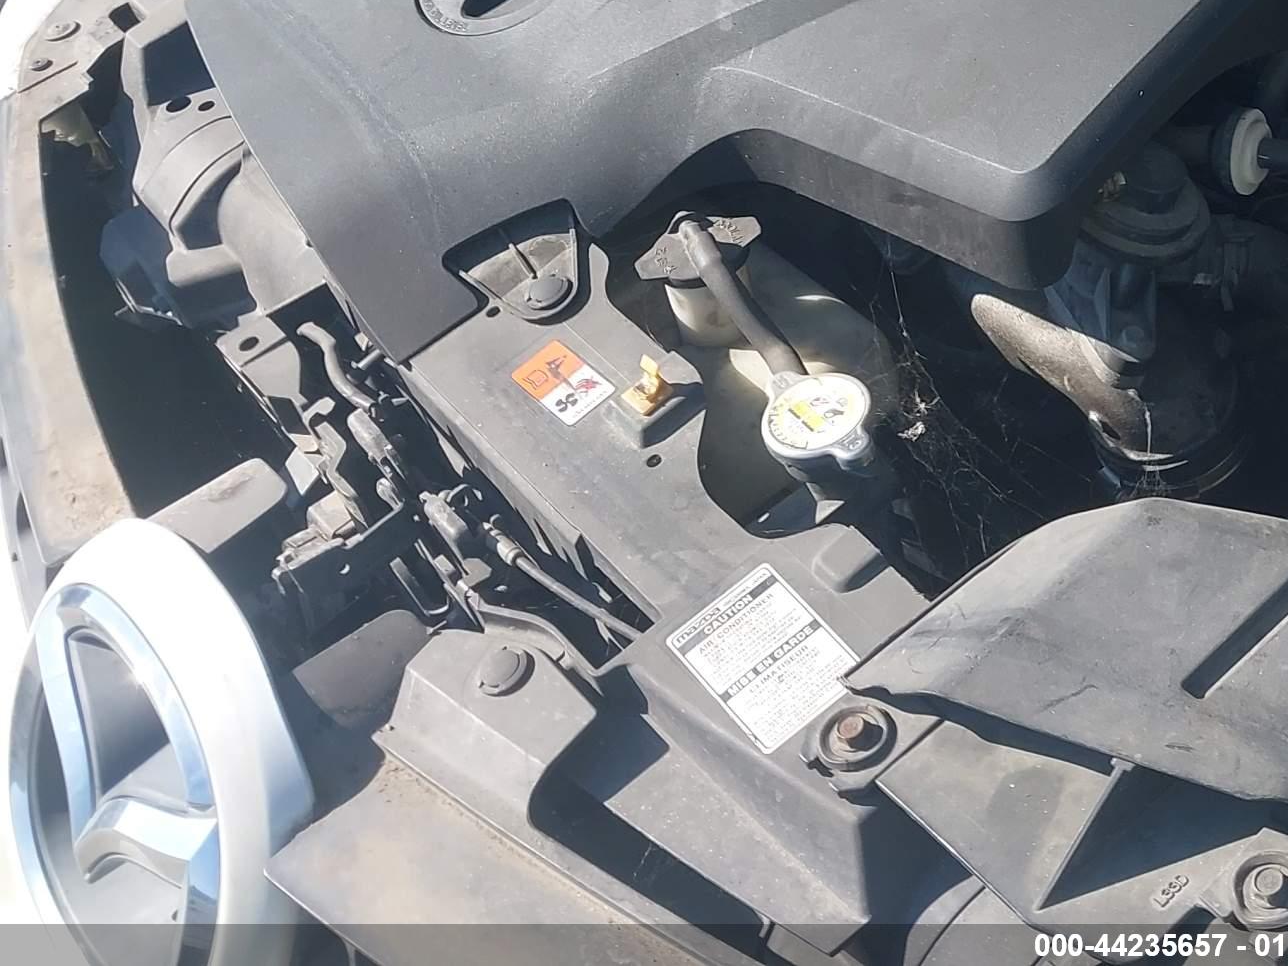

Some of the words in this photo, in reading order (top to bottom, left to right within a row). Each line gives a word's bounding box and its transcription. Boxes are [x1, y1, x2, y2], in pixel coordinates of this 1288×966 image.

[703, 593, 753, 635] CAUTION
[698, 639, 714, 654] AIR
[726, 669, 756, 698] MISE
[754, 657, 774, 676] EN
[772, 624, 814, 661] GARDE
